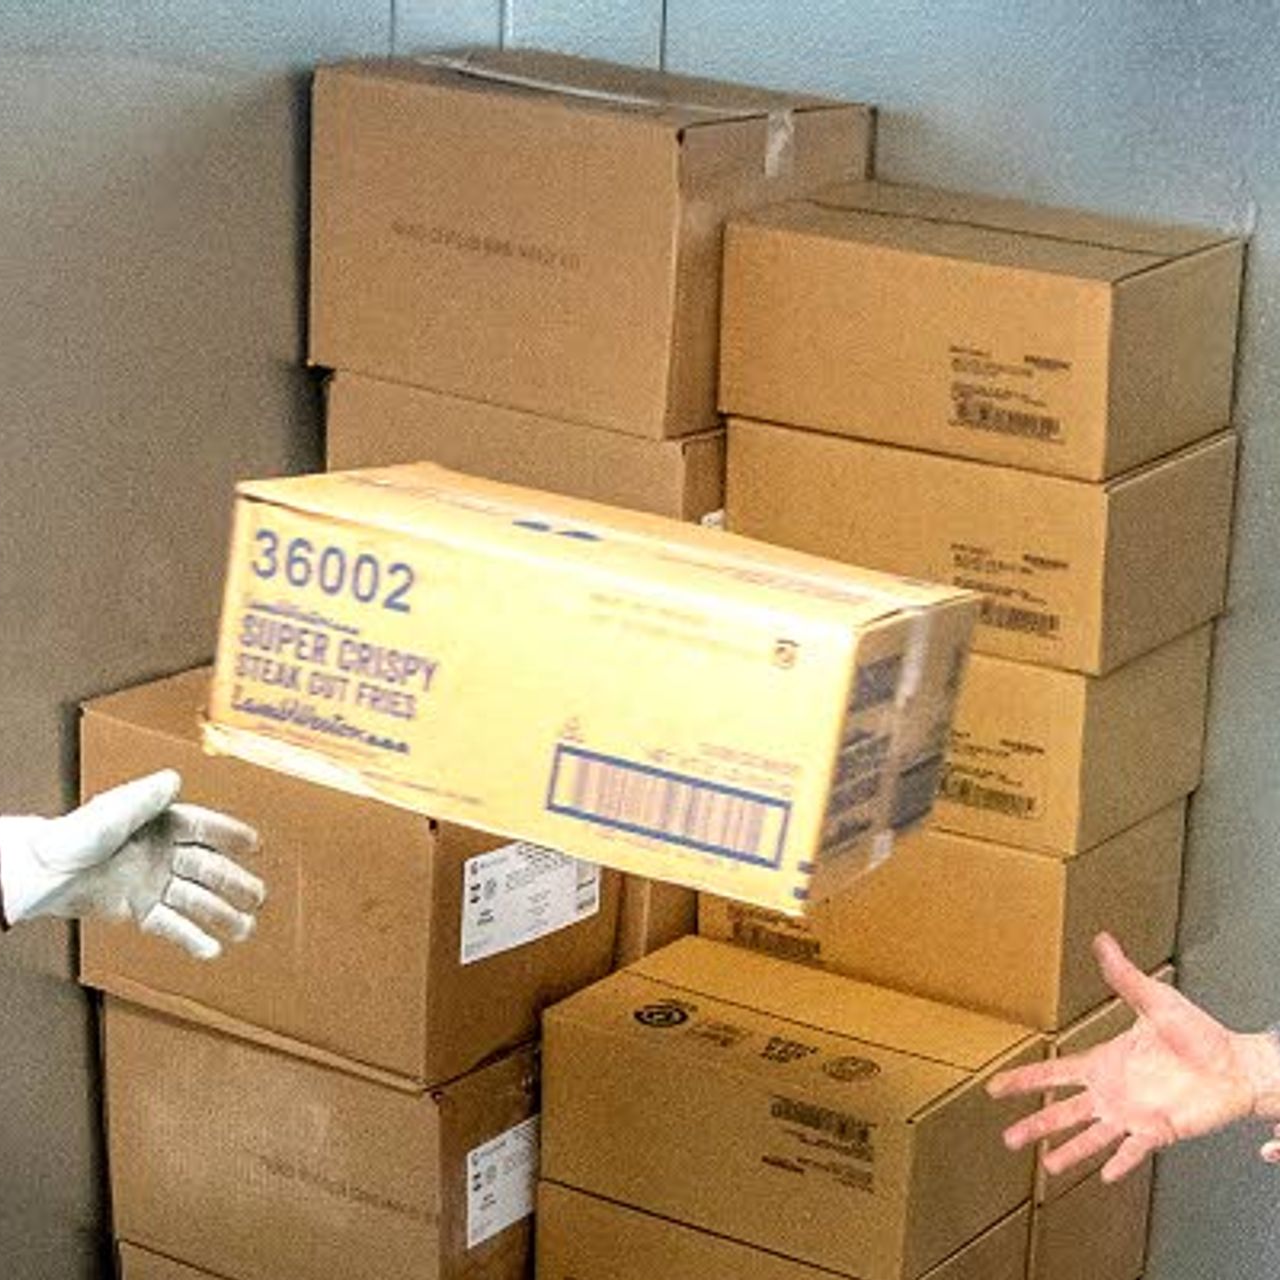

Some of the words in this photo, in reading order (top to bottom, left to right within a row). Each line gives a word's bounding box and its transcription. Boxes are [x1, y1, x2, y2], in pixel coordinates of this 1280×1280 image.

[251, 528, 415, 613] 36002
[235, 653, 300, 690] STEAK
[356, 681, 418, 720] FRIES
[240, 613, 328, 666] SUPER
[337, 639, 439, 692] CRISPY
